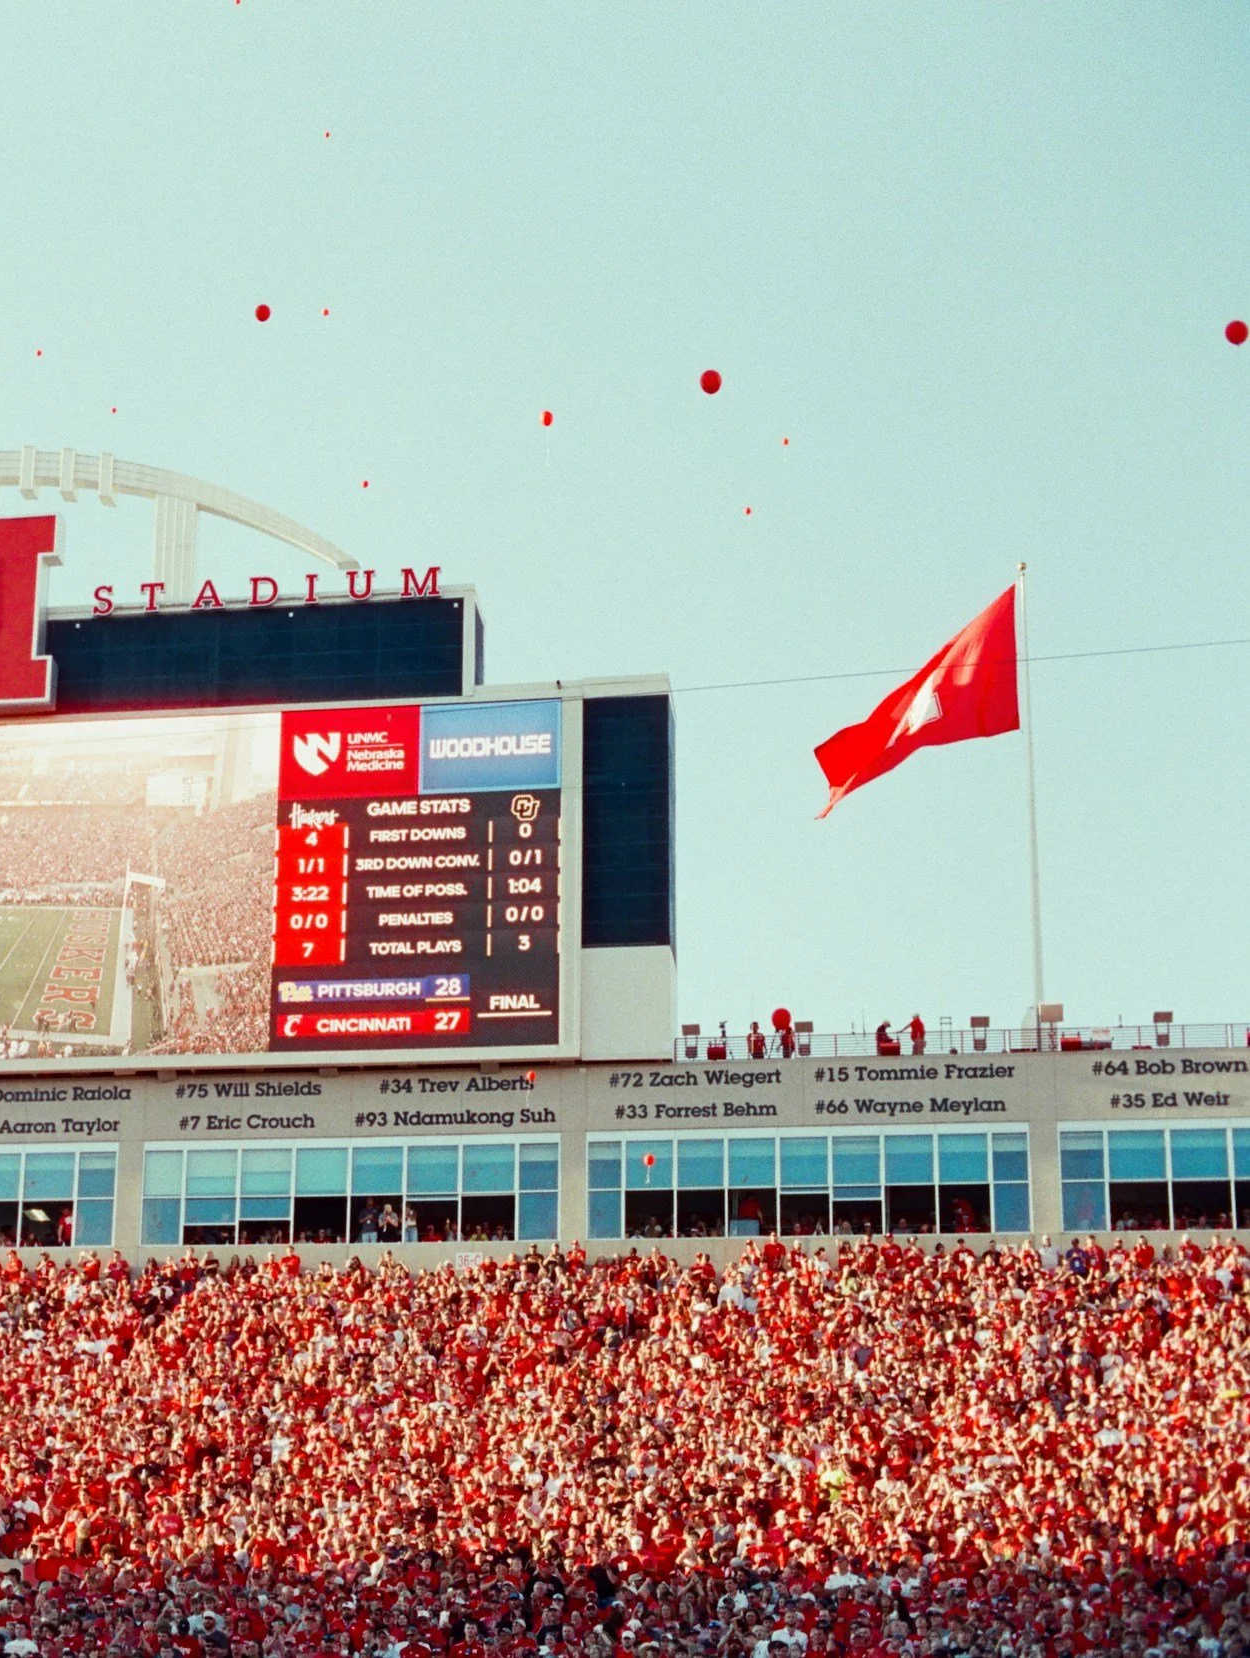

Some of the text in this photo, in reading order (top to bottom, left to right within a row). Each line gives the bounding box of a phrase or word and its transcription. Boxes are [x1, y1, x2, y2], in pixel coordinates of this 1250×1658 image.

[92, 567, 441, 616] STADIUM
[347, 731, 388, 745] UNMC
[346, 748, 405, 761] Nebraska
[429, 734, 551, 760] WOODHOUSE
[346, 759, 405, 773] Medicine
[367, 799, 471, 817] GAME STATS
[370, 826, 466, 842] FIRST DOWNS
[519, 822, 532, 838] 0
[305, 831, 318, 847] 4
[355, 855, 480, 871] 3RD DOWN CONV.
[291, 886, 329, 902] 3:22
[366, 882, 468, 899] TIME OF POSS.
[507, 877, 542, 894] 1:04
[378, 911, 453, 926] PENALTIES
[302, 942, 315, 958] 7
[369, 939, 462, 955] TOTAL PLAYS
[518, 934, 531, 951] 3
[317, 981, 421, 998] PITTSBURGH
[434, 978, 462, 996] 28
[489, 994, 540, 1011] FINAL
[316, 1016, 411, 1034] CINCINNATI
[433, 1012, 462, 1031] 27
[814, 1063, 1016, 1082] #15 Tommie Frazier
[1092, 1058, 1248, 1076] #64 Bob Brown
[379, 1078, 413, 1094] #34
[418, 1078, 460, 1093] Trev
[608, 1069, 782, 1088] #72 Zach Wiegert
[72, 1085, 132, 1101] Raiola
[175, 1080, 322, 1098] #75 Will Shields
[815, 1097, 1007, 1116] #66 Wayne Meylan
[1110, 1091, 1230, 1109] #35 Ed Weir
[355, 1107, 556, 1128] #93 Ndamukong Suh
[615, 1102, 778, 1119] #33 Forrest Behm
[61, 1118, 120, 1136] Taylor
[179, 1113, 315, 1131] #7 Eric Crouch
